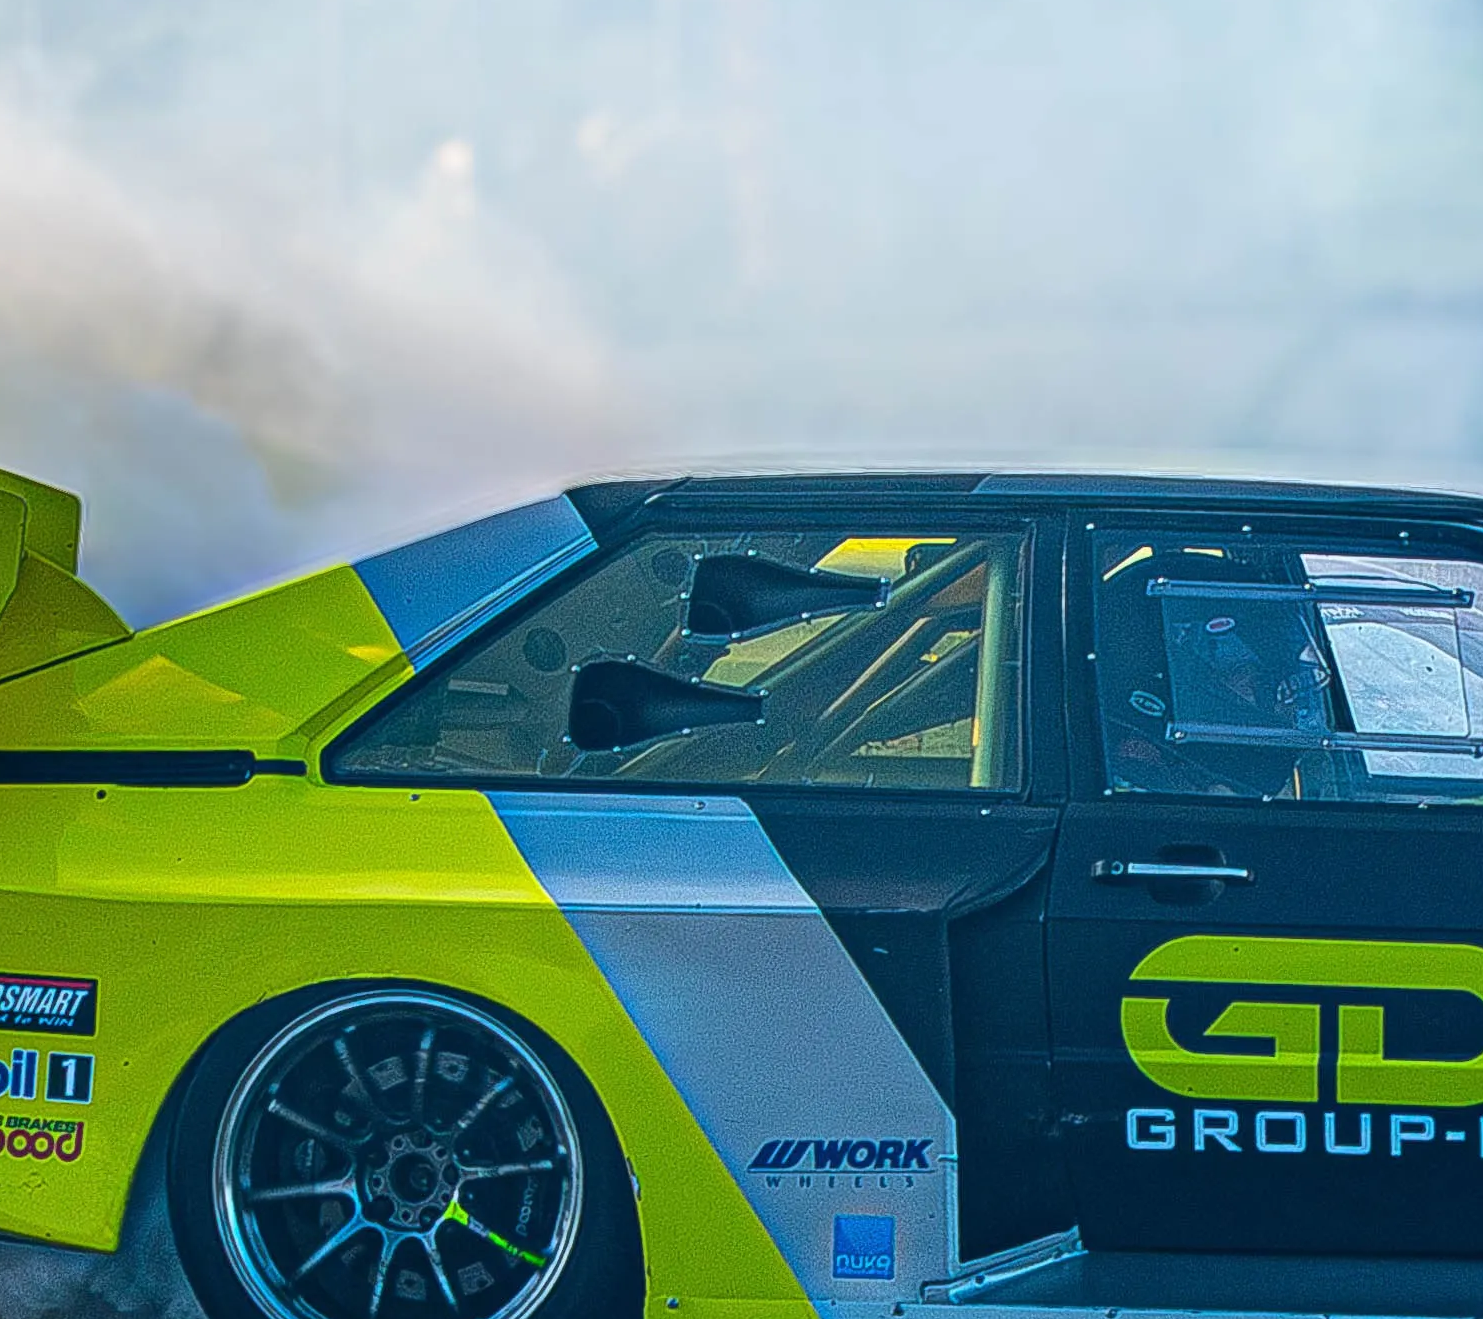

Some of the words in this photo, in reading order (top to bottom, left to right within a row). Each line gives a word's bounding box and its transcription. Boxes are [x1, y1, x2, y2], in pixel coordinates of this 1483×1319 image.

[14, 1013, 32, 1024] to
[5, 1115, 78, 1134] BRAKES
[814, 1138, 934, 1170] WORK
